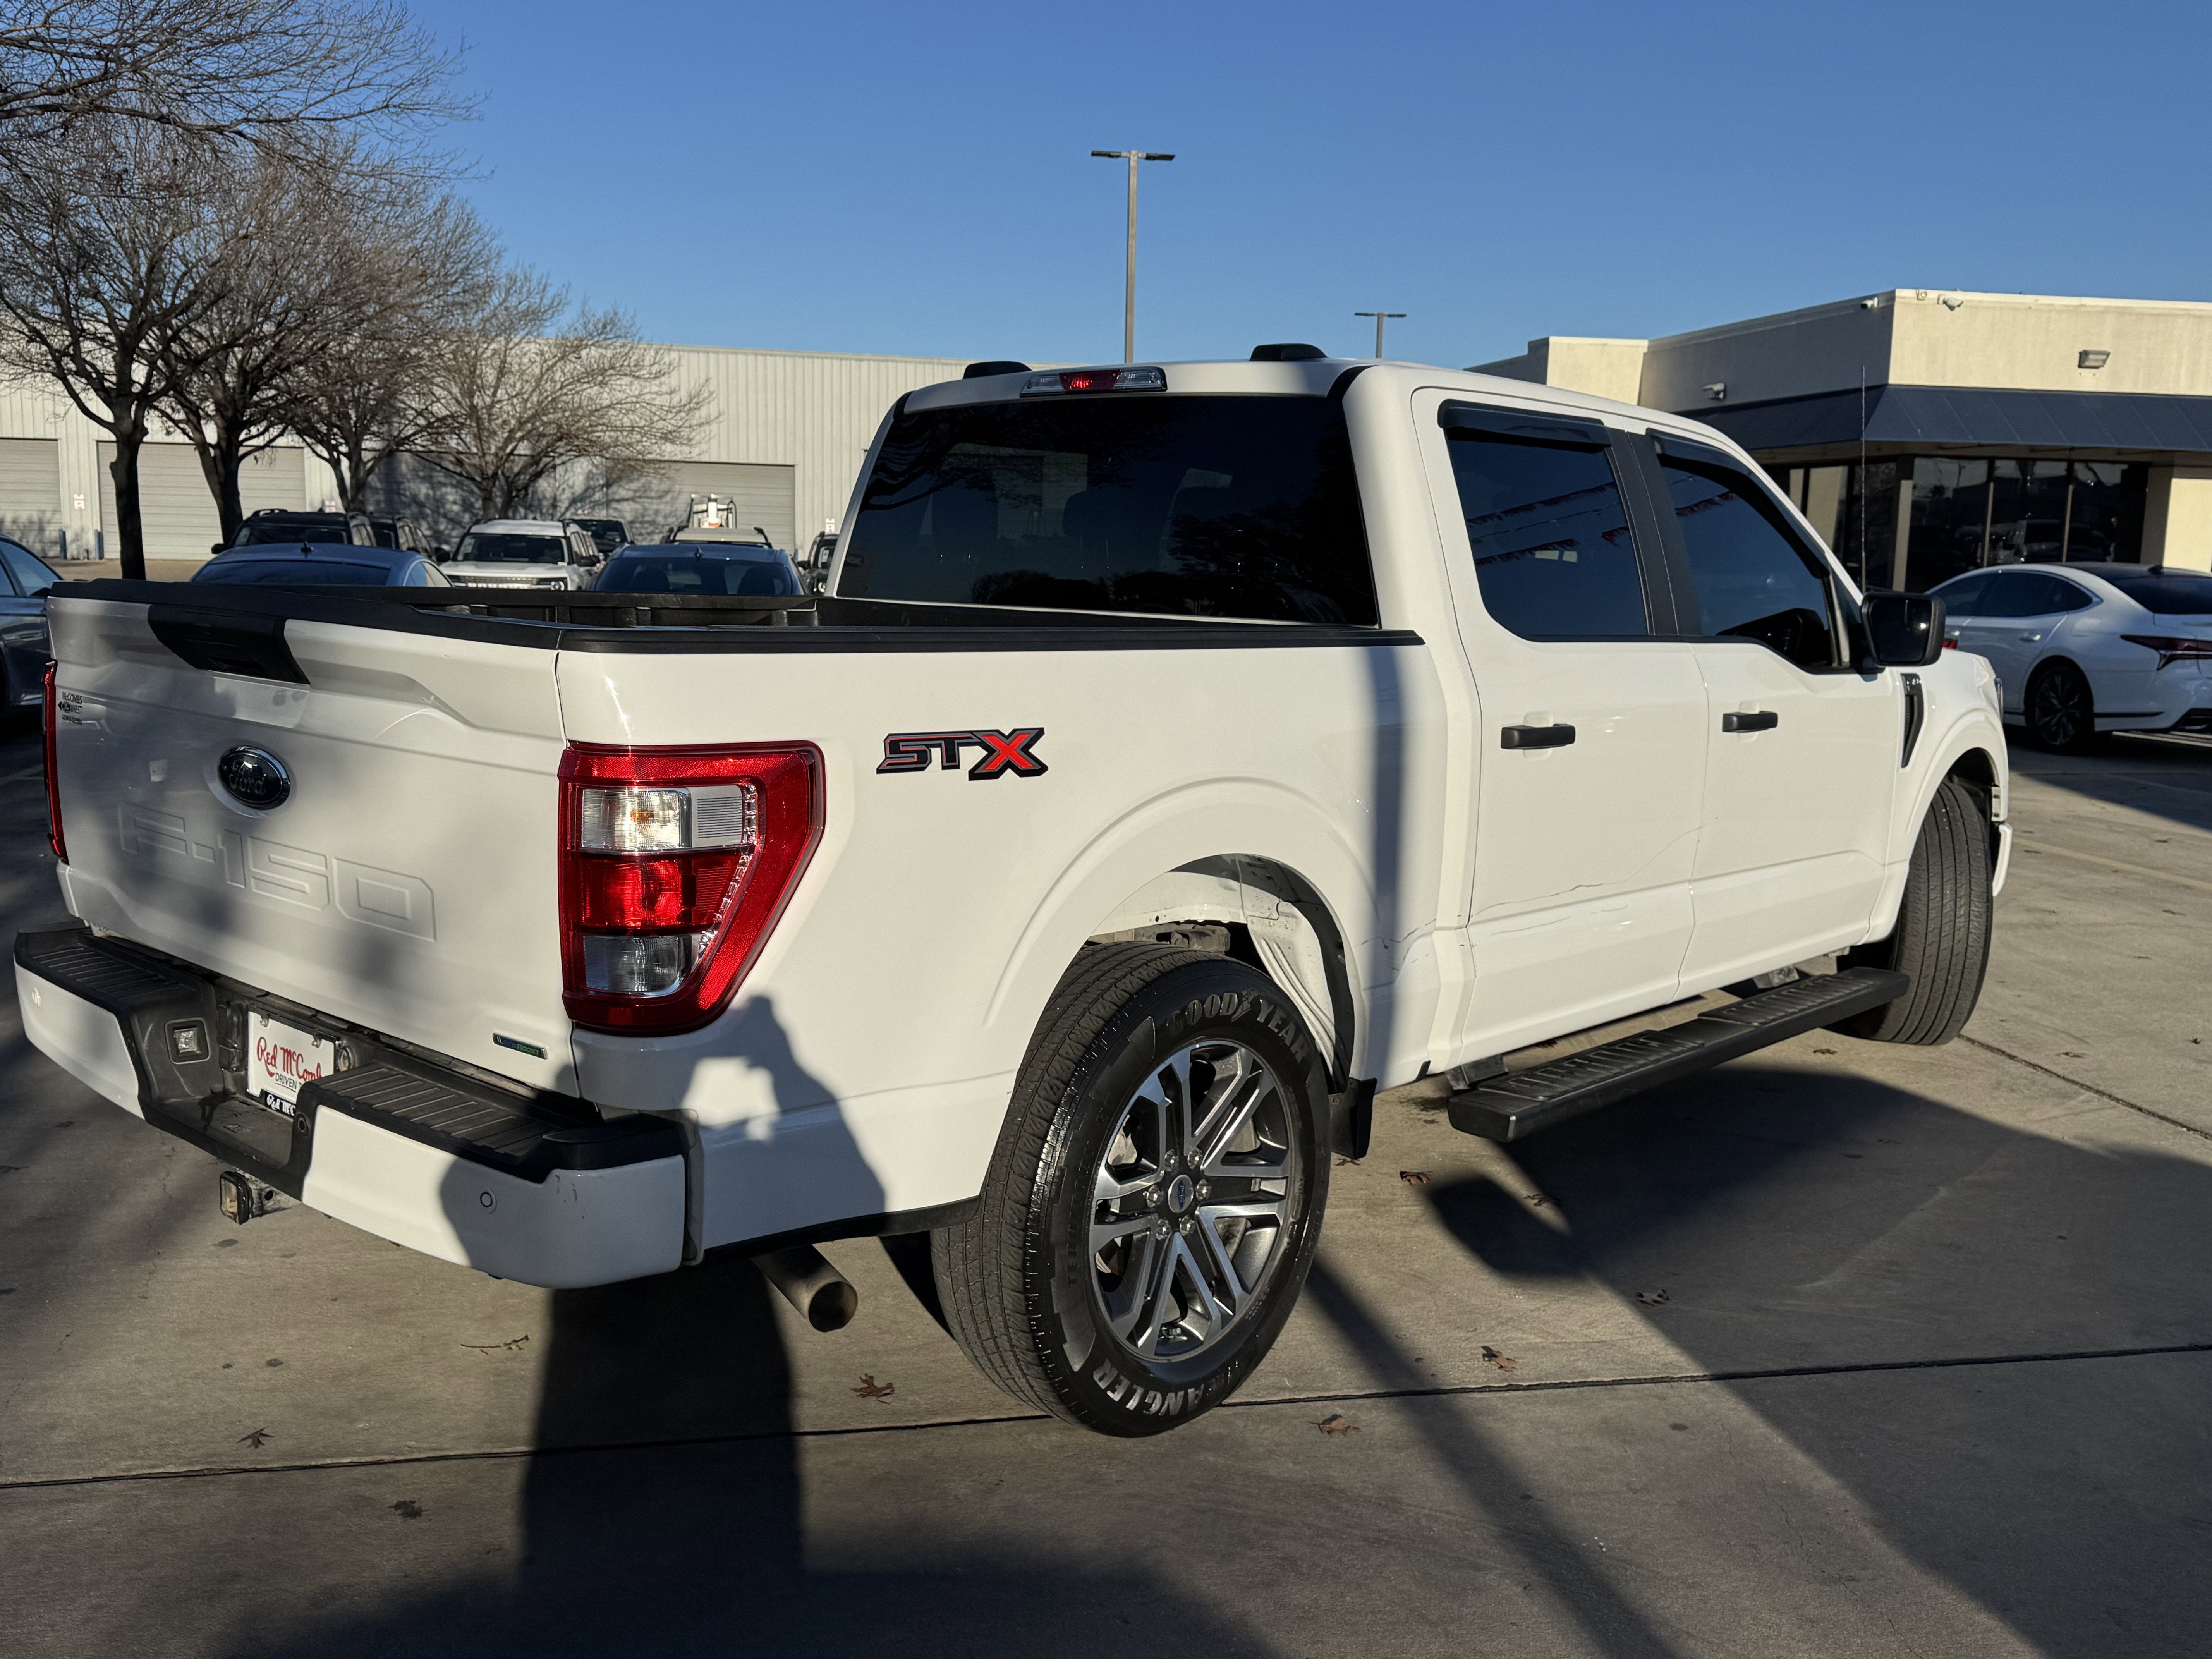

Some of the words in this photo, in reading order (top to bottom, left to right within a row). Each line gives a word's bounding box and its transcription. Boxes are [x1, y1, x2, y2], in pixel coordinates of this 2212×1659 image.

[876, 727, 1048, 781] STX
[118, 802, 437, 942] F-150
[257, 1036, 278, 1077] Red
[279, 1046, 323, 1082] McComb
[275, 1073, 297, 1090] DRIVEN
